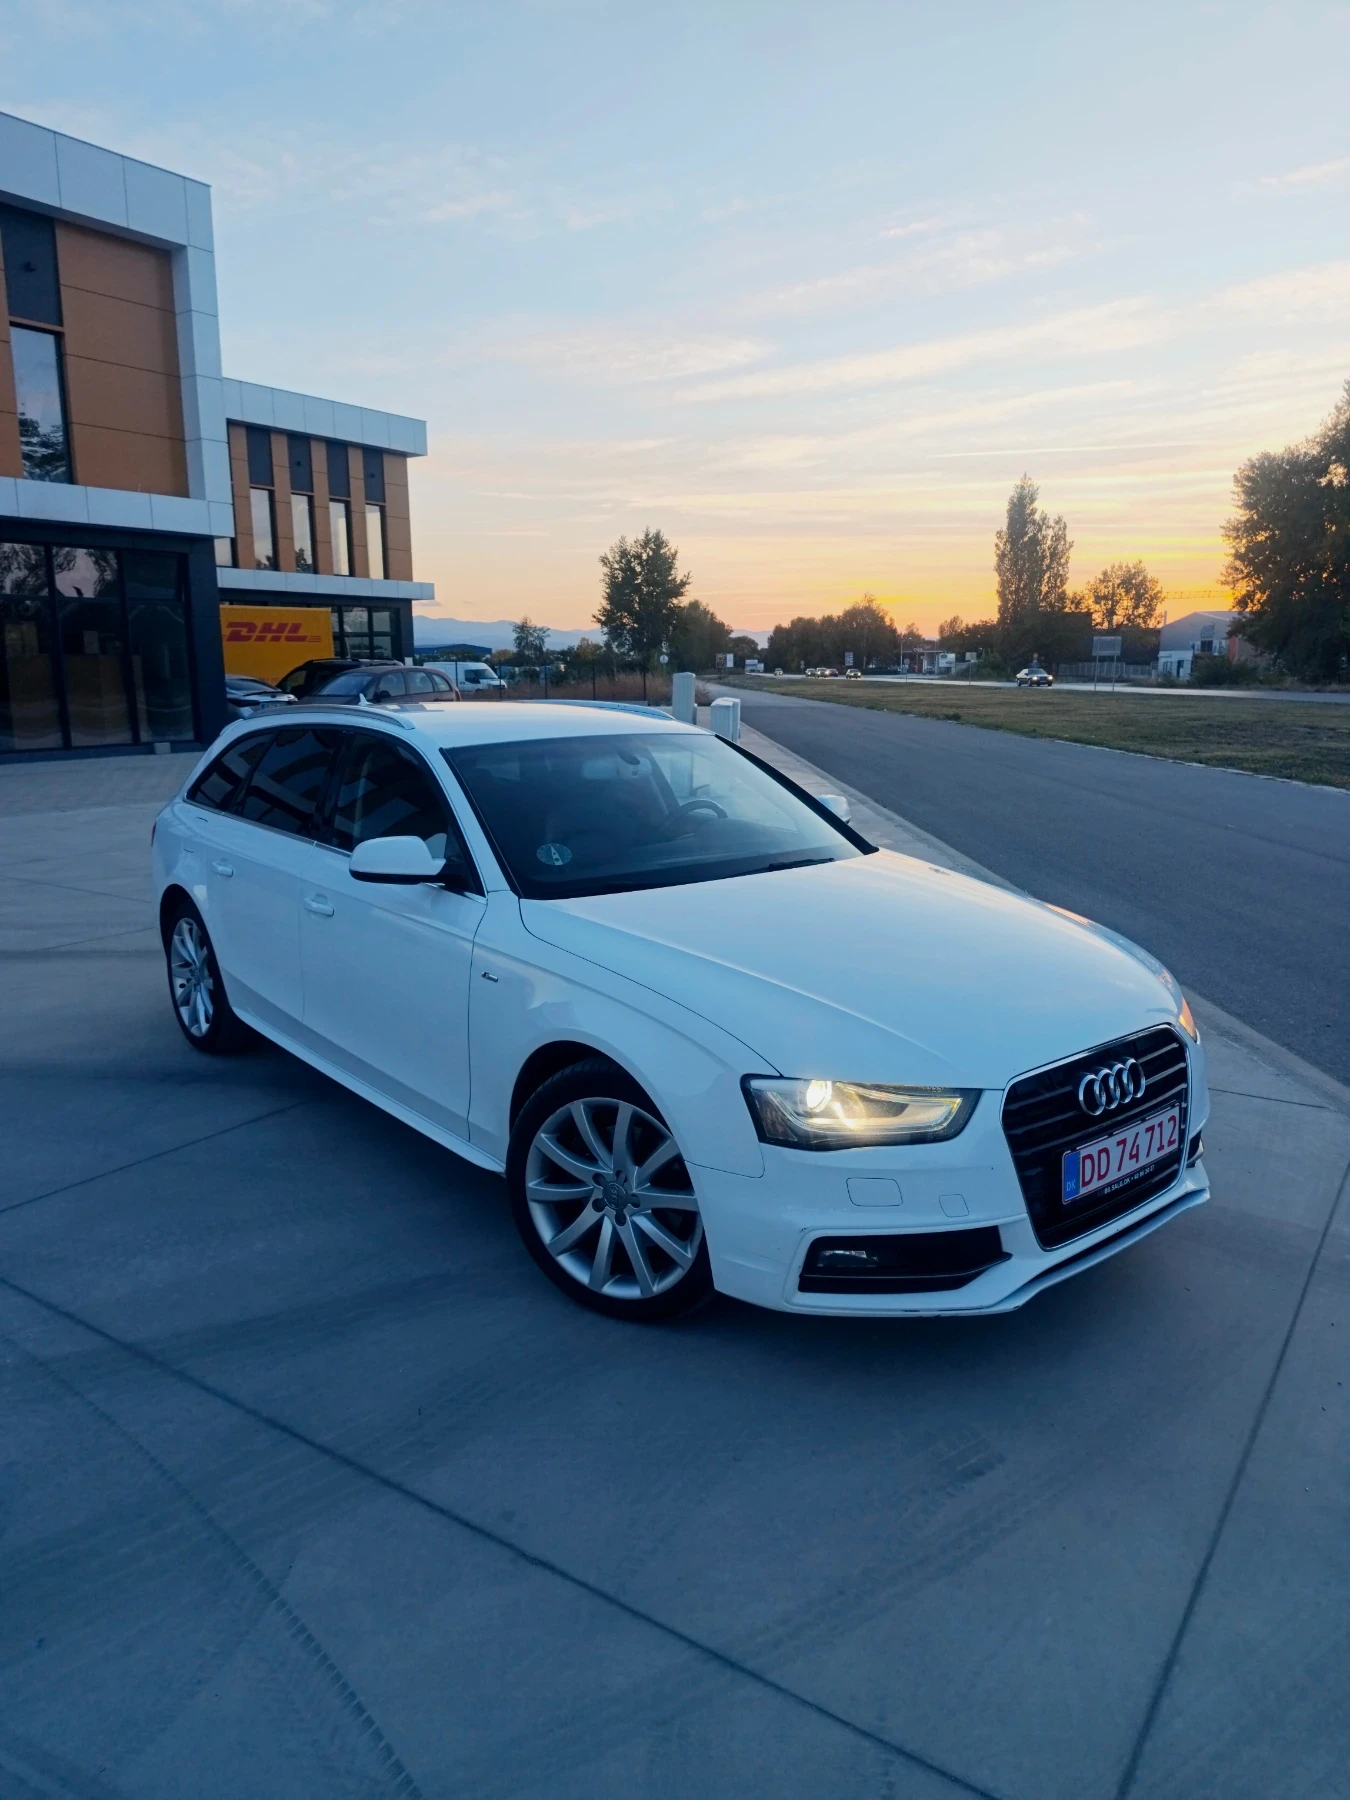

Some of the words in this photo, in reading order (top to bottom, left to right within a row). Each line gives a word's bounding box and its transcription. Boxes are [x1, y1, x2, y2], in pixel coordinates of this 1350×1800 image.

[226, 621, 308, 642] DHL
[1081, 1147, 1110, 1188] DD
[1116, 1132, 1140, 1172] 74
[1145, 1115, 1177, 1158] 712
[1066, 1179, 1076, 1192] DK
